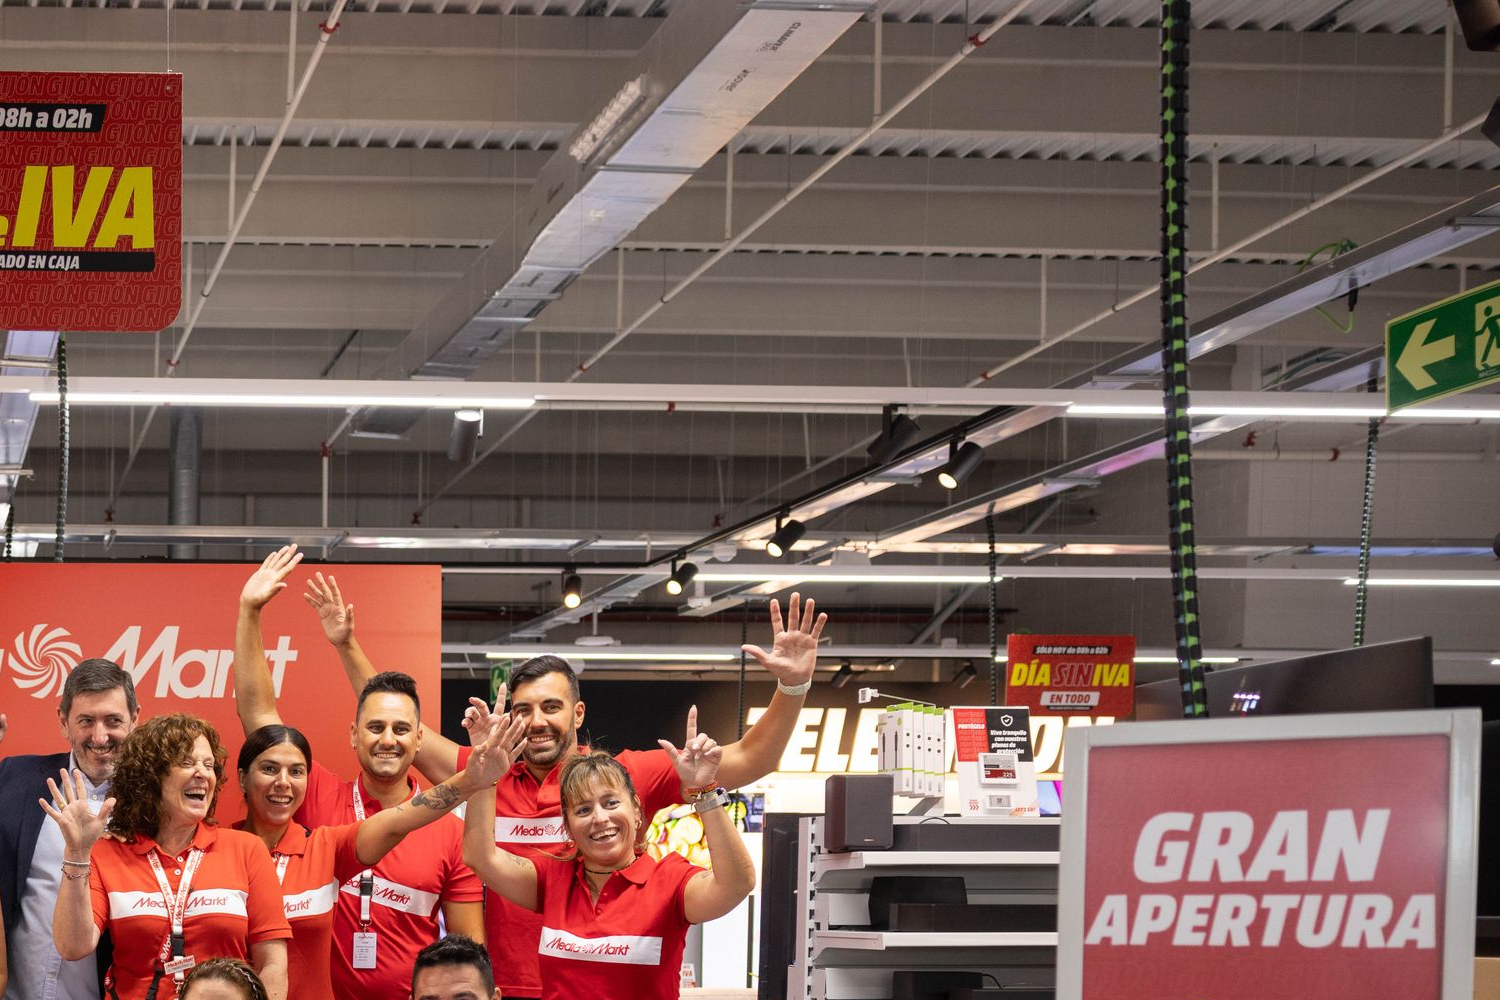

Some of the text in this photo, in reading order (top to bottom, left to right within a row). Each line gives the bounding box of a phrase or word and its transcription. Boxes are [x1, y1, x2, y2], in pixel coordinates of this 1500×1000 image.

[36, 111, 49, 128] a
[52, 108, 93, 129] 02h
[12, 164, 155, 249] IVA
[27, 255, 46, 269] EN
[48, 256, 80, 271] CAJA
[1010, 659, 1130, 688] DÍA SIN IVA
[1050, 694, 1091, 704] EN TODO
[510, 825, 544, 836] Media
[1133, 809, 1390, 883] GRAN
[187, 896, 227, 910] Markt
[377, 887, 411, 905] Markt
[1085, 893, 1436, 949] APERTURA
[592, 943, 630, 956] Markt
